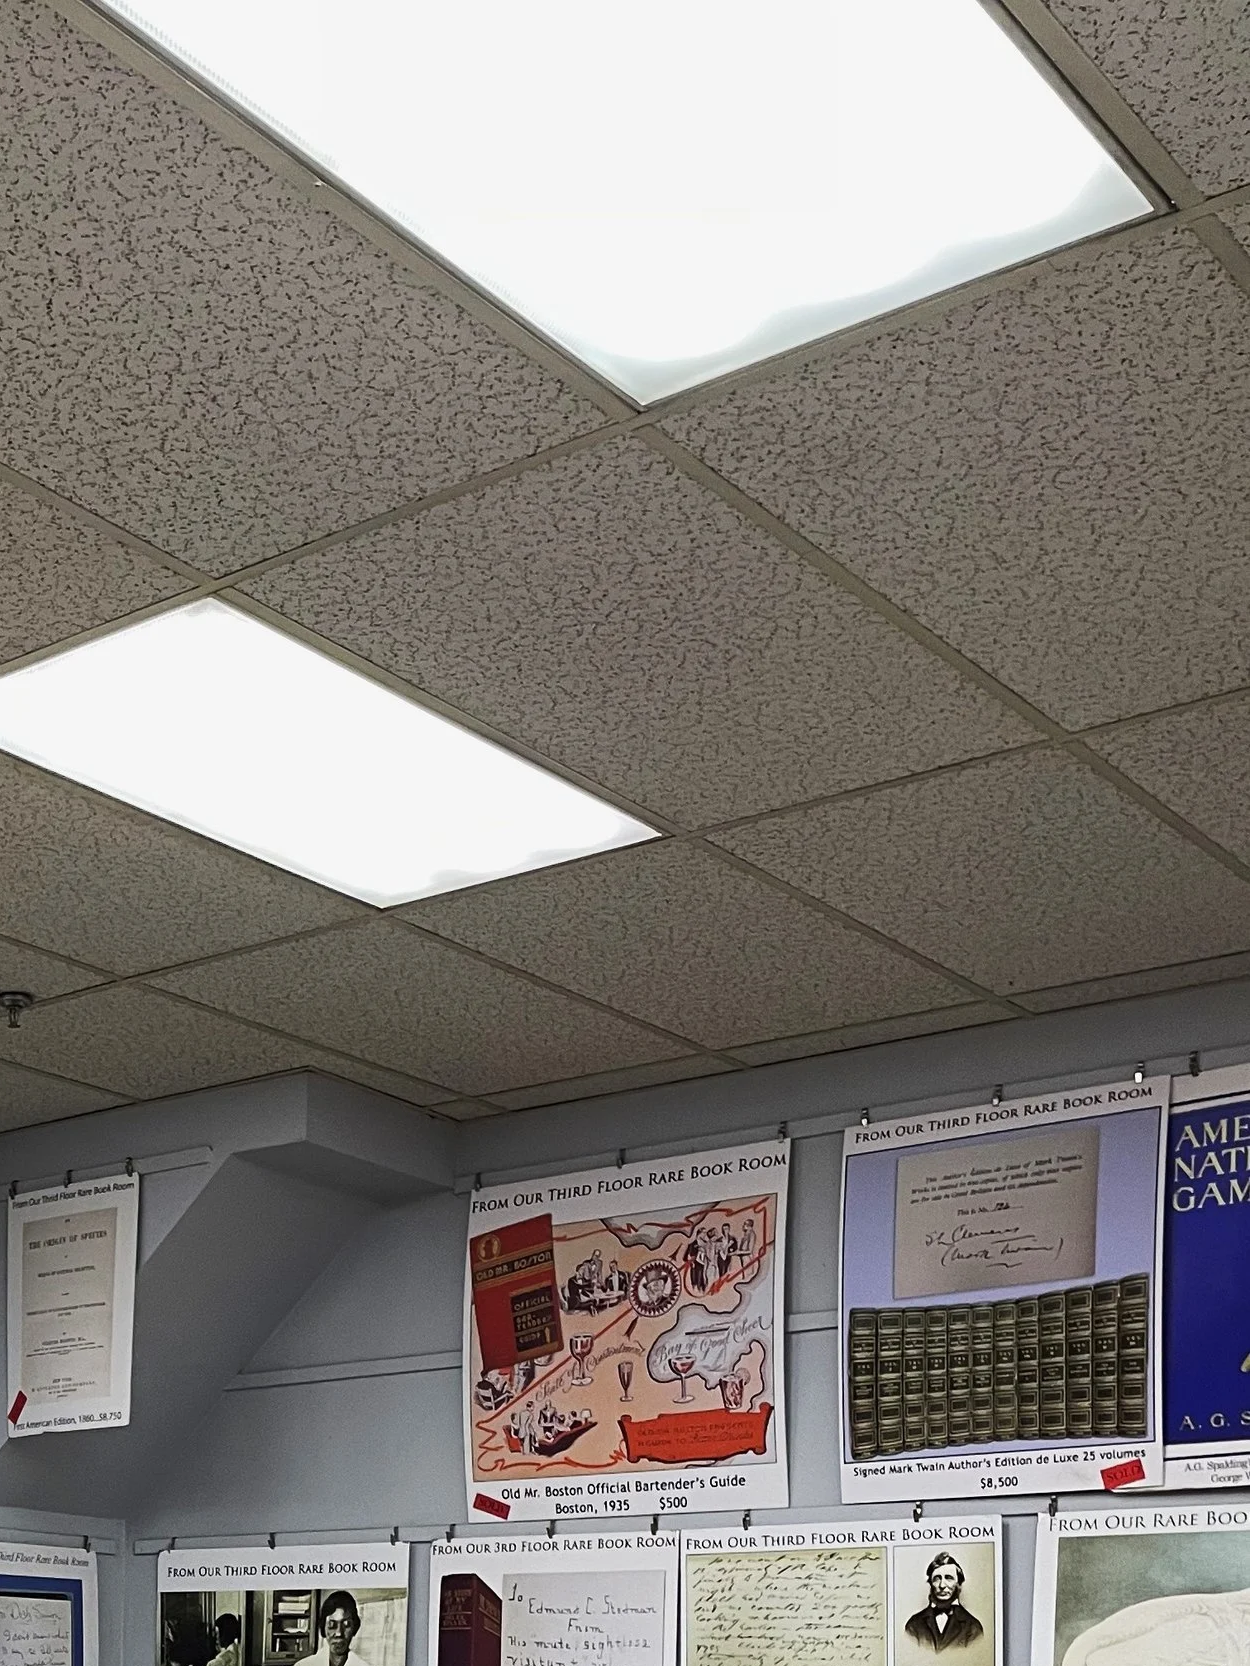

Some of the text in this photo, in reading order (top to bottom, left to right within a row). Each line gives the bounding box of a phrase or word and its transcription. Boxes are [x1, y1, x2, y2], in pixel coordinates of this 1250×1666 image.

[472, 1153, 787, 1213] FROM OUR THIRD FLOOR RARE BOOK ROOM
[853, 1448, 1146, 1478] Signed Mark Twain Author's Edition de Luxe 25 volumes
[1105, 1463, 1143, 1482] SOLD
[501, 1473, 746, 1501] Old Mr. Boston Official Bartender's Guide
[980, 1476, 1018, 1490] $8,500
[555, 1496, 688, 1515] Boston, 1935 $500
